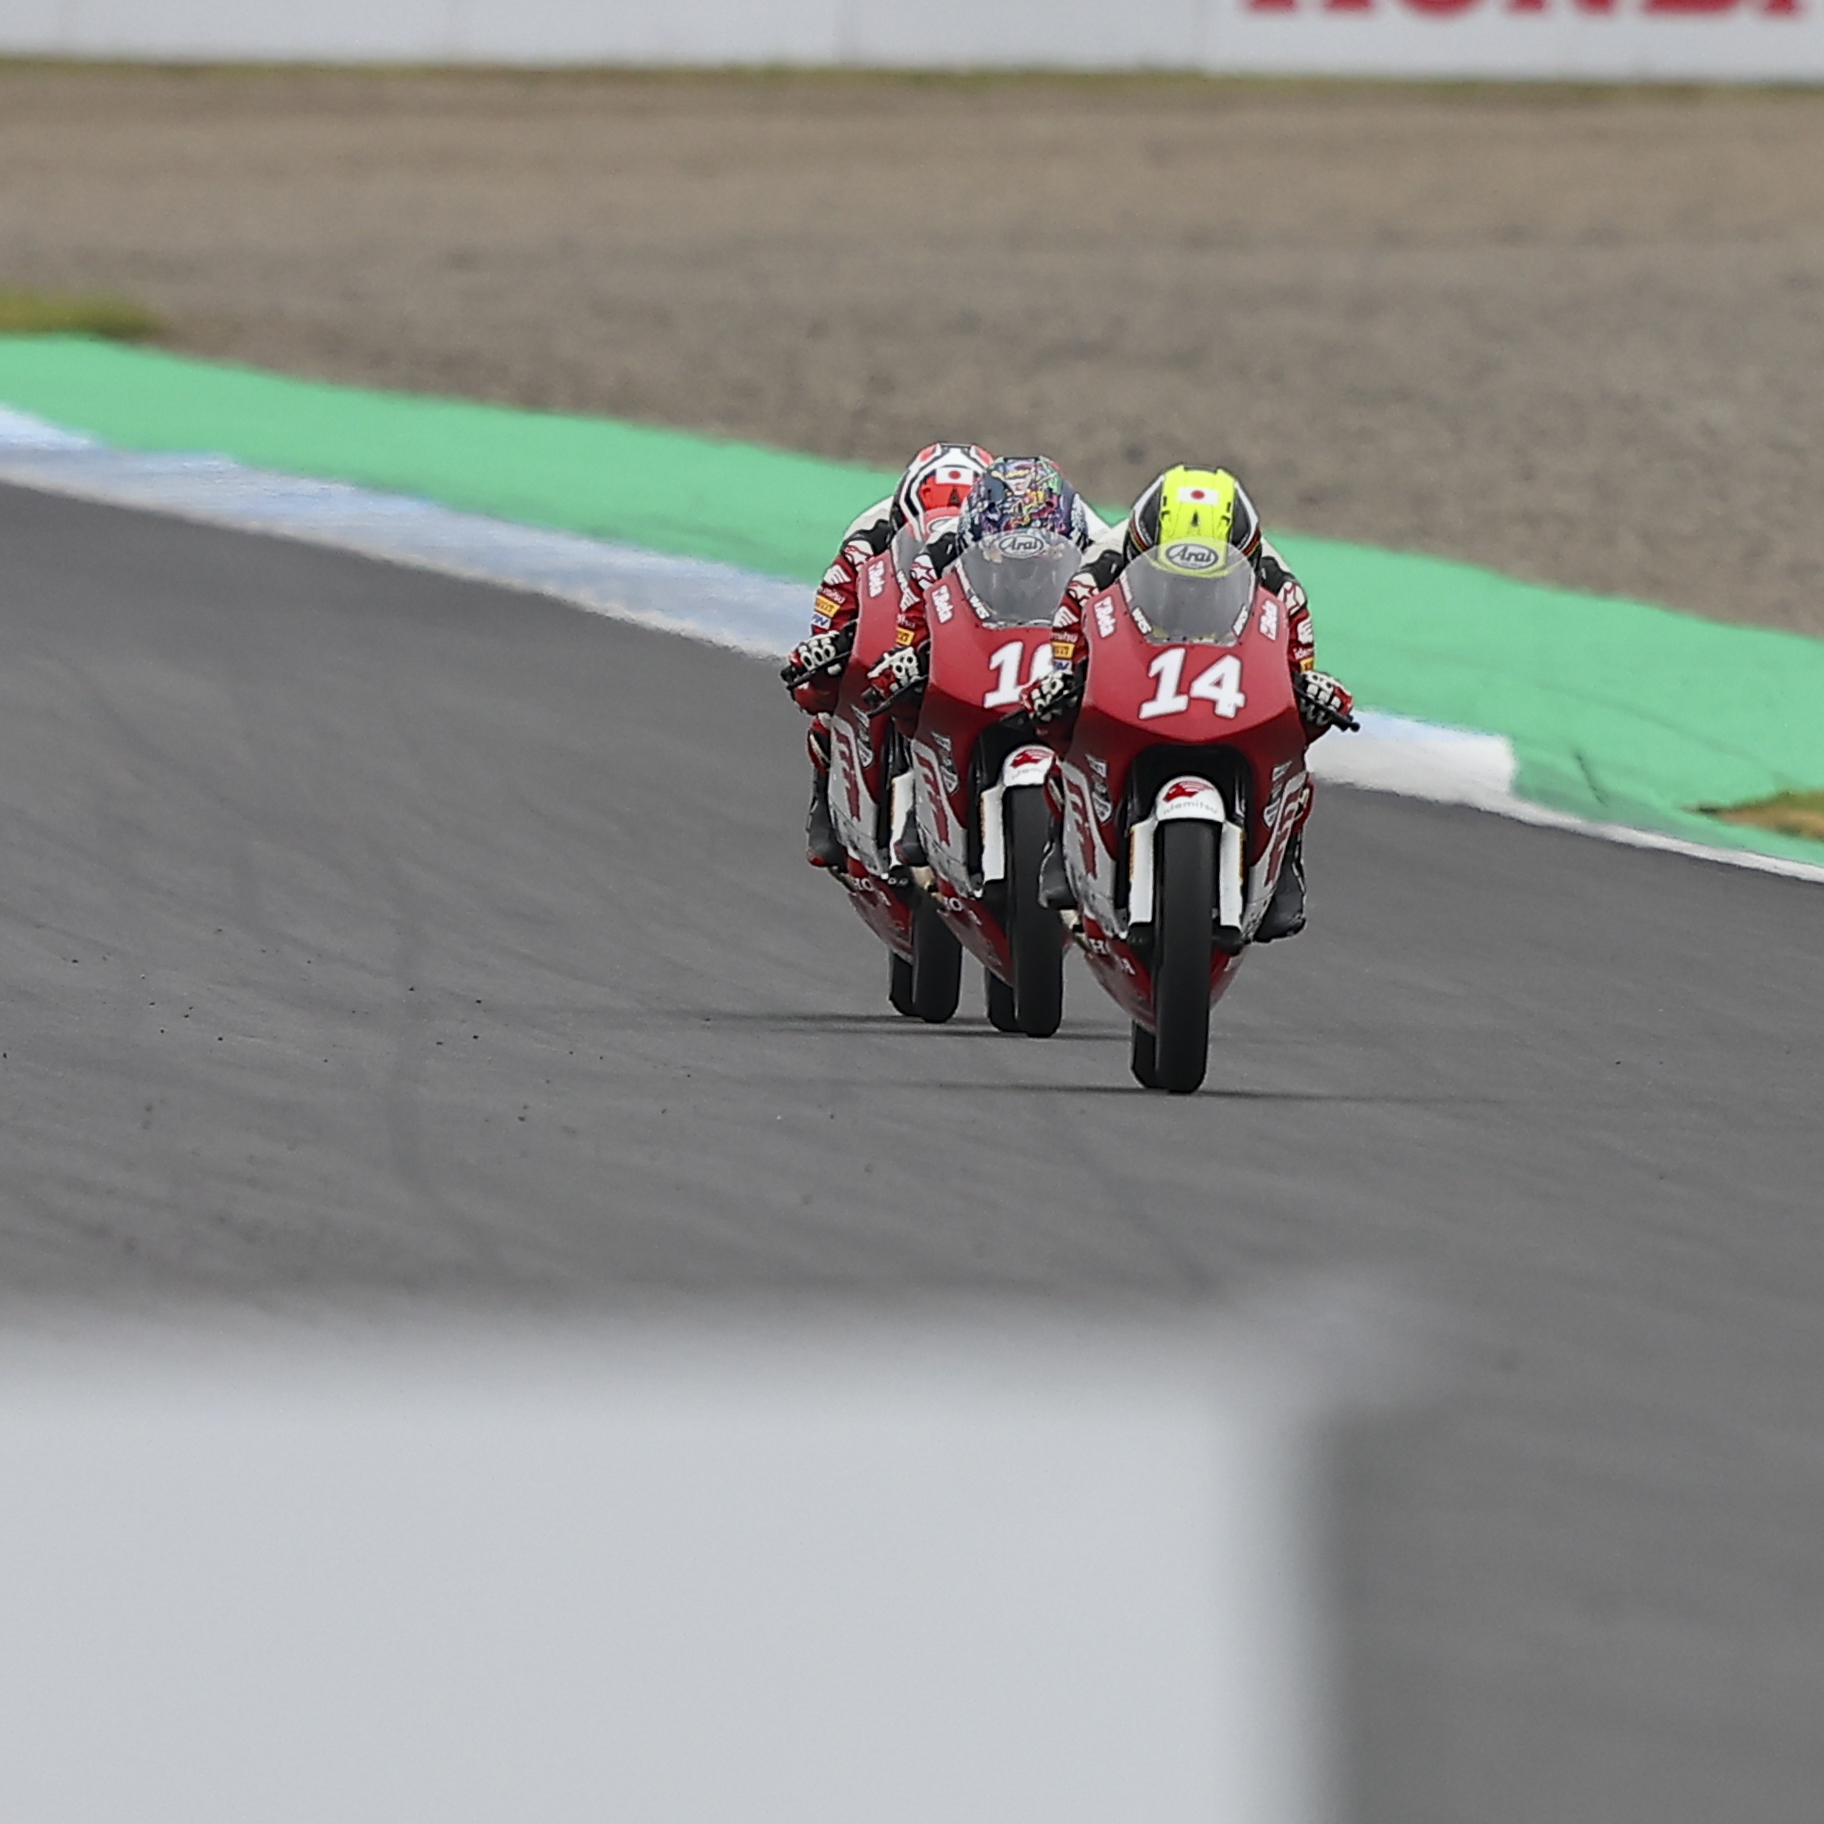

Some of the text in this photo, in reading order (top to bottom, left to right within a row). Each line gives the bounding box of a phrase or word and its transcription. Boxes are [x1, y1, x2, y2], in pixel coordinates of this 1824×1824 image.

[1001, 536, 1037, 551] Arai
[1168, 544, 1212, 562] Arai
[1138, 646, 1247, 721] 14
